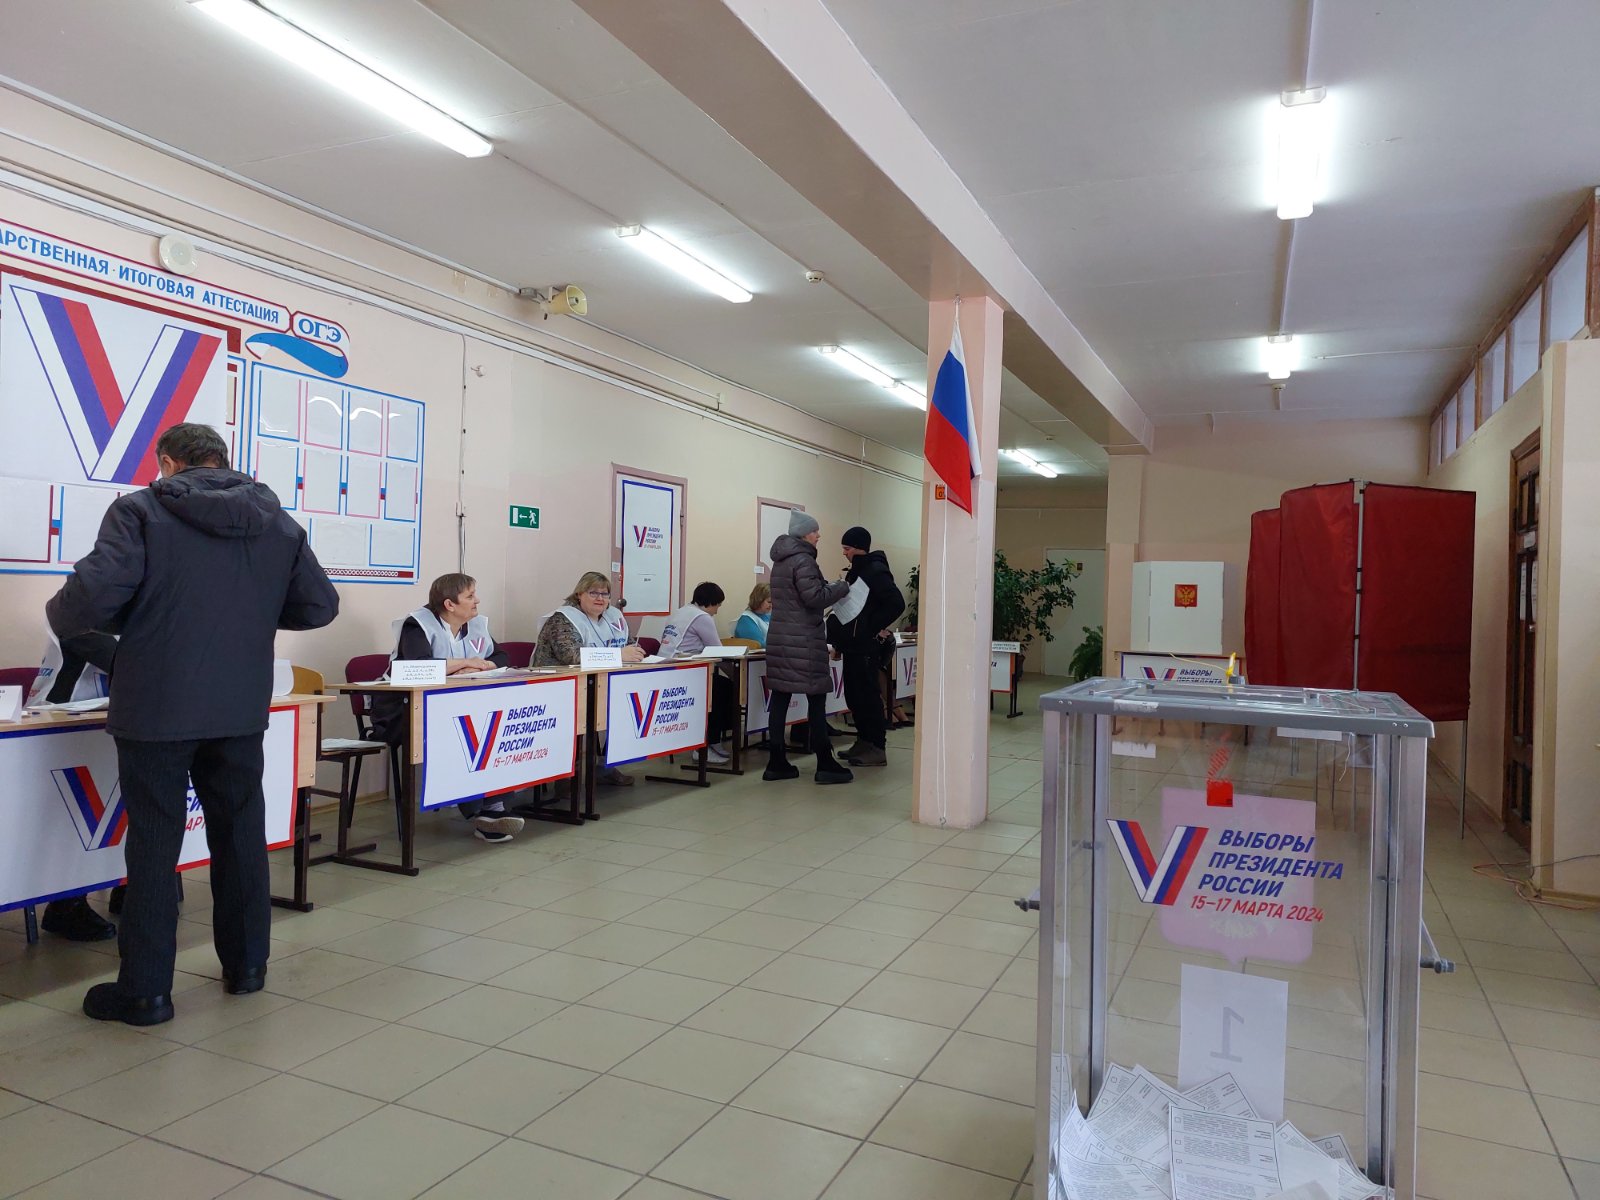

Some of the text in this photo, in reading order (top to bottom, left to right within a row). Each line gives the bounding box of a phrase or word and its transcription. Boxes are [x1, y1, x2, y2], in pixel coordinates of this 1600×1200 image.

[0, 228, 279, 324] РСТВЕННАЯ ИТОГОВАЯ АТТЕСТАЦИЯ
[298, 318, 342, 343] ОГЭ
[1179, 668, 1213, 677] ВЫБОРЫ
[662, 686, 688, 699] ВЫБОРЫ
[507, 704, 547, 721] ВЫБОРЫ
[659, 697, 695, 711] ПРЕЗИДЕНТА
[502, 717, 557, 737] ПРЕЗИДЕНТА
[655, 712, 679, 725] РОССИИ
[664, 723, 679, 734] МАРТА
[497, 736, 535, 754] РОССИИ
[511, 750, 534, 765] МАРТА
[533, 747, 549, 760] 2024
[1218, 829, 1316, 853] ВЫБОРЫ
[1208, 851, 1344, 880] ПРЕЗИДЕНТА
[1198, 873, 1285, 898] РОССИИ
[1232, 899, 1284, 919] МАРТА
[1286, 905, 1326, 922] 2024
